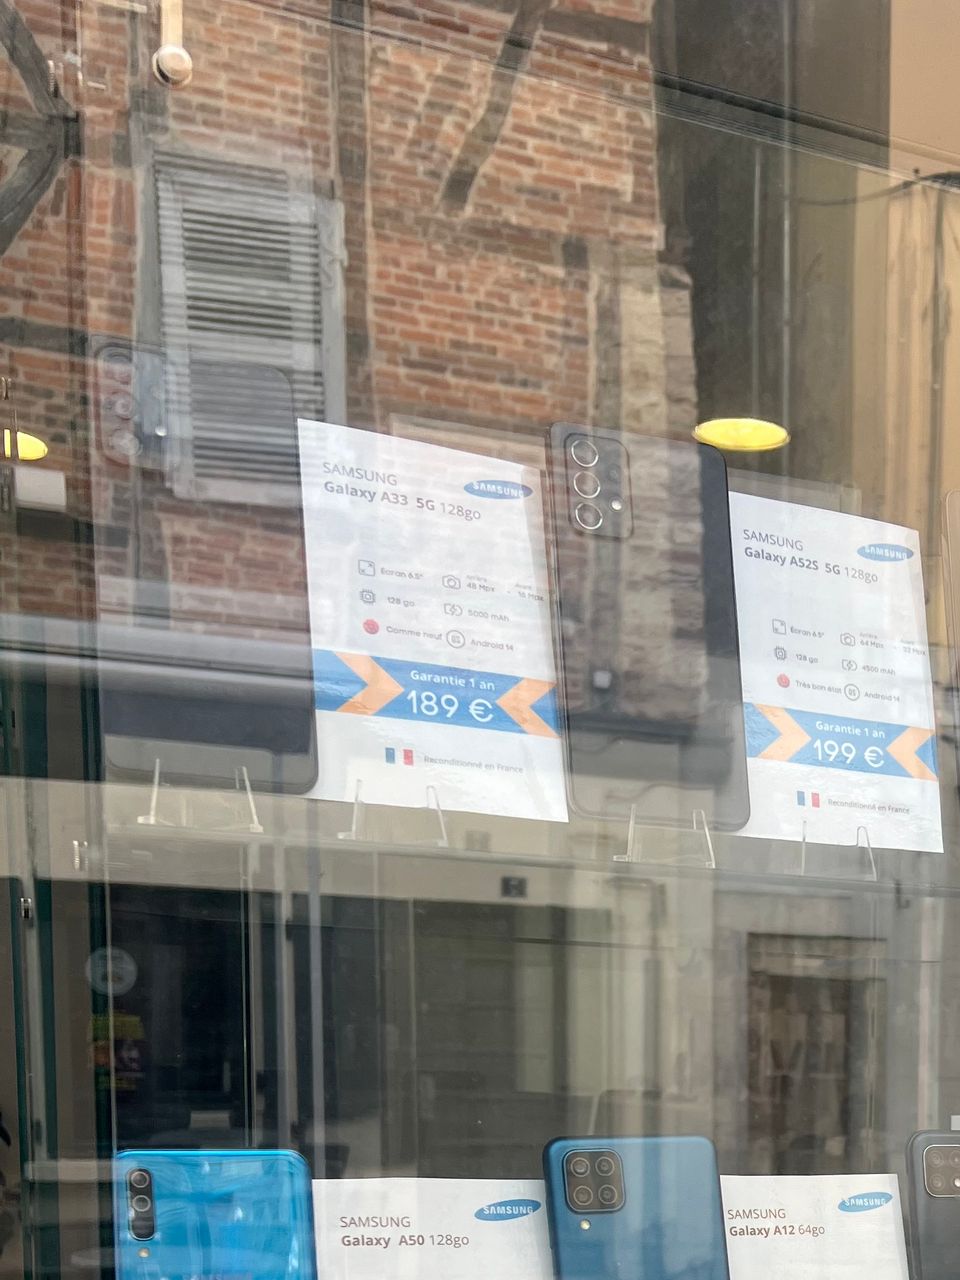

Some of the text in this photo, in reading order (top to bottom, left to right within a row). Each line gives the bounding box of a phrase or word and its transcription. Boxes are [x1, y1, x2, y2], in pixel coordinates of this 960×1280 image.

[322, 462, 398, 486] SAMSUNG
[472, 481, 524, 498] SAMSUNG
[324, 481, 482, 521] Galaxy A33 5G 128go
[743, 529, 804, 551] SAMSUNG
[744, 547, 787, 566] Galaxy
[825, 563, 841, 575] 5G
[844, 566, 878, 584] 128go
[410, 670, 496, 691] Garantie 1 an
[406, 690, 494, 722] 189 €
[816, 721, 885, 739] Garantie 1 an
[813, 739, 885, 768] 199 €
[482, 1203, 534, 1216] SAMSUNG
[845, 1197, 887, 1208] SAMSUNG
[340, 1216, 411, 1228] SAMSUNG
[728, 1208, 786, 1220] SAMSUNG
[729, 1224, 825, 1238] Galaxy A12 64go
[341, 1234, 470, 1249] Galaxy A50 128go
